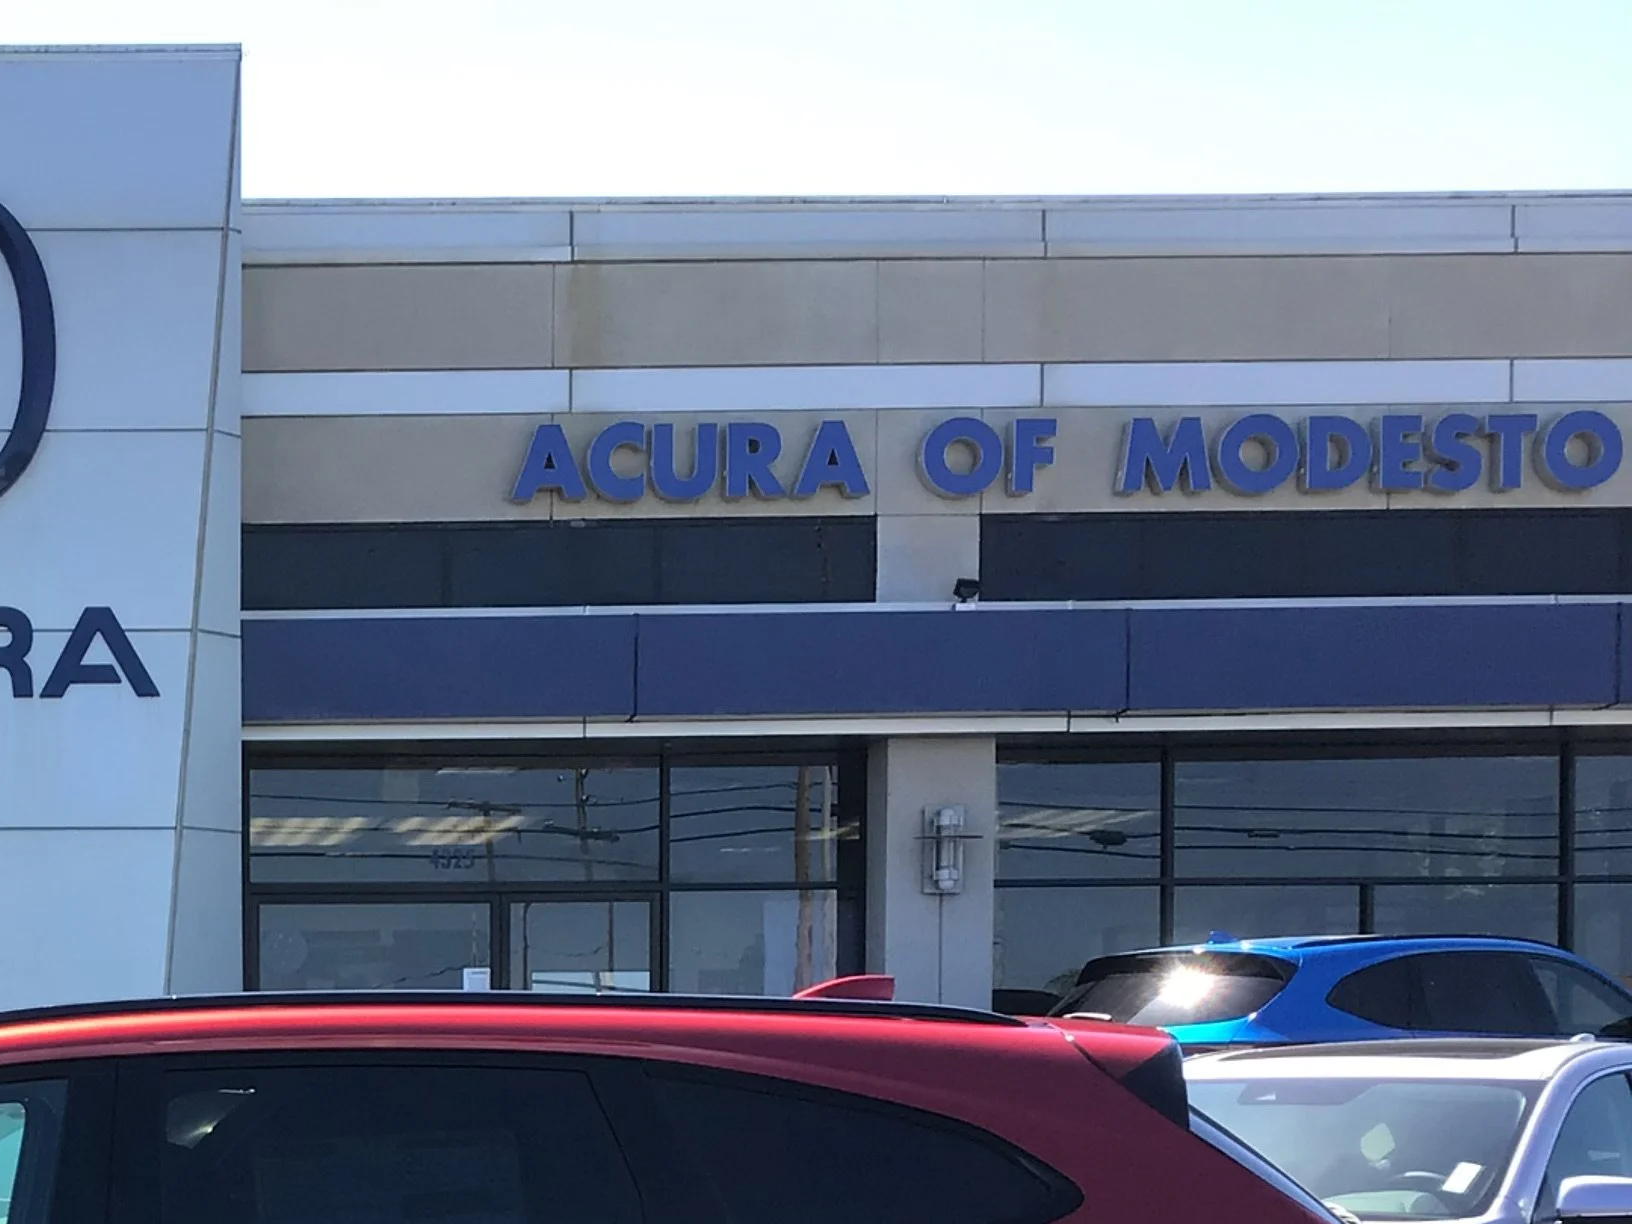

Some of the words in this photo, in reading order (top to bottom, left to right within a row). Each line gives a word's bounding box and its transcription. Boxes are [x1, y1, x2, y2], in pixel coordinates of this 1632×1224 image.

[510, 419, 871, 502] ACURA
[915, 416, 1058, 500] OF
[1115, 410, 1624, 495] MODESTO
